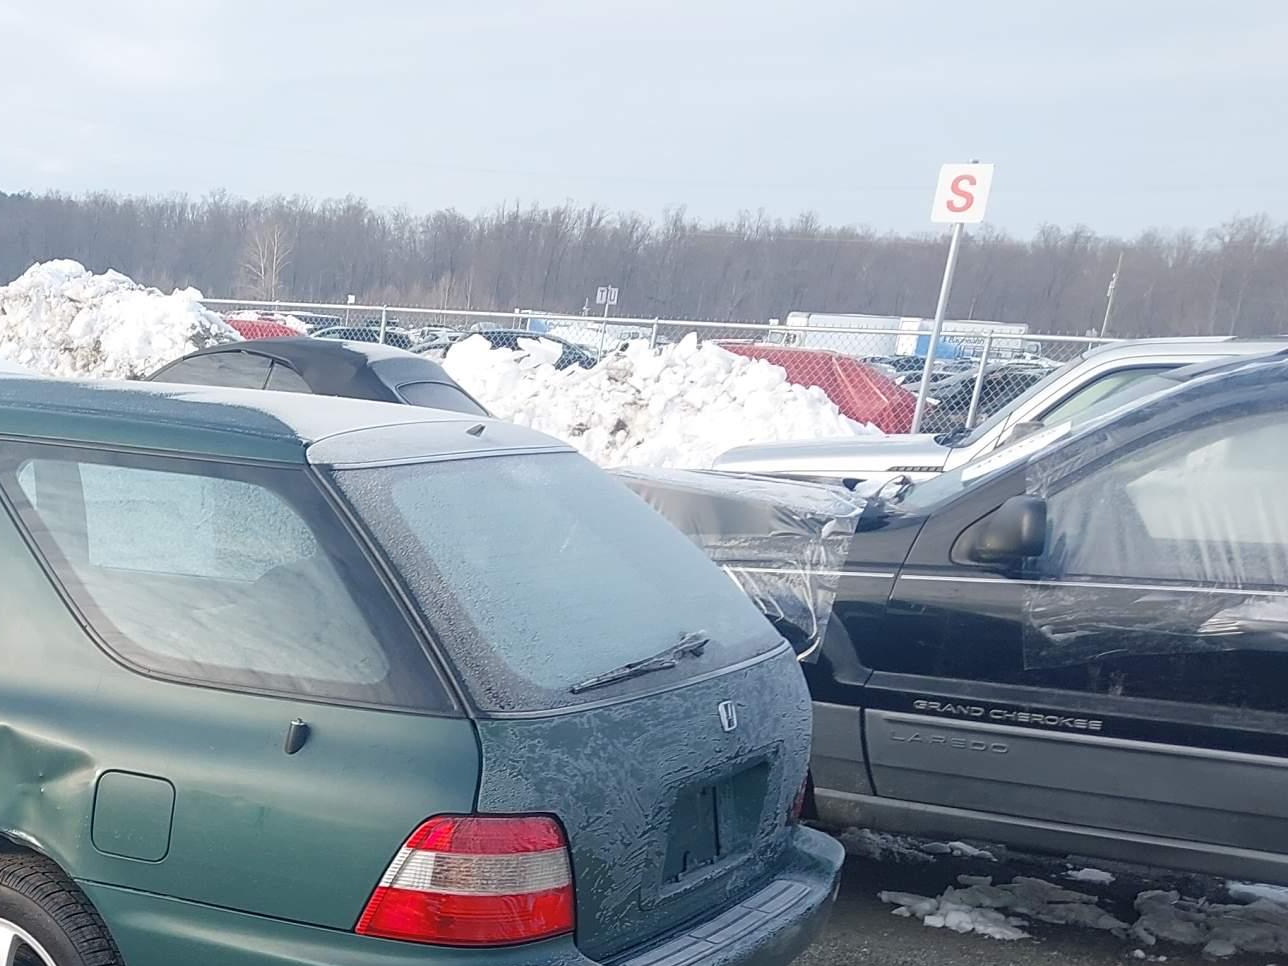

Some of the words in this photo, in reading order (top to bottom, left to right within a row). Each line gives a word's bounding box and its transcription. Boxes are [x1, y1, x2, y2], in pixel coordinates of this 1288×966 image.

[945, 174, 978, 213] S
[599, 288, 606, 302] T
[609, 288, 617, 302] U
[912, 699, 985, 717] GRAND
[988, 709, 1103, 731] CHEROKEE
[889, 730, 1010, 754] LAREDO
